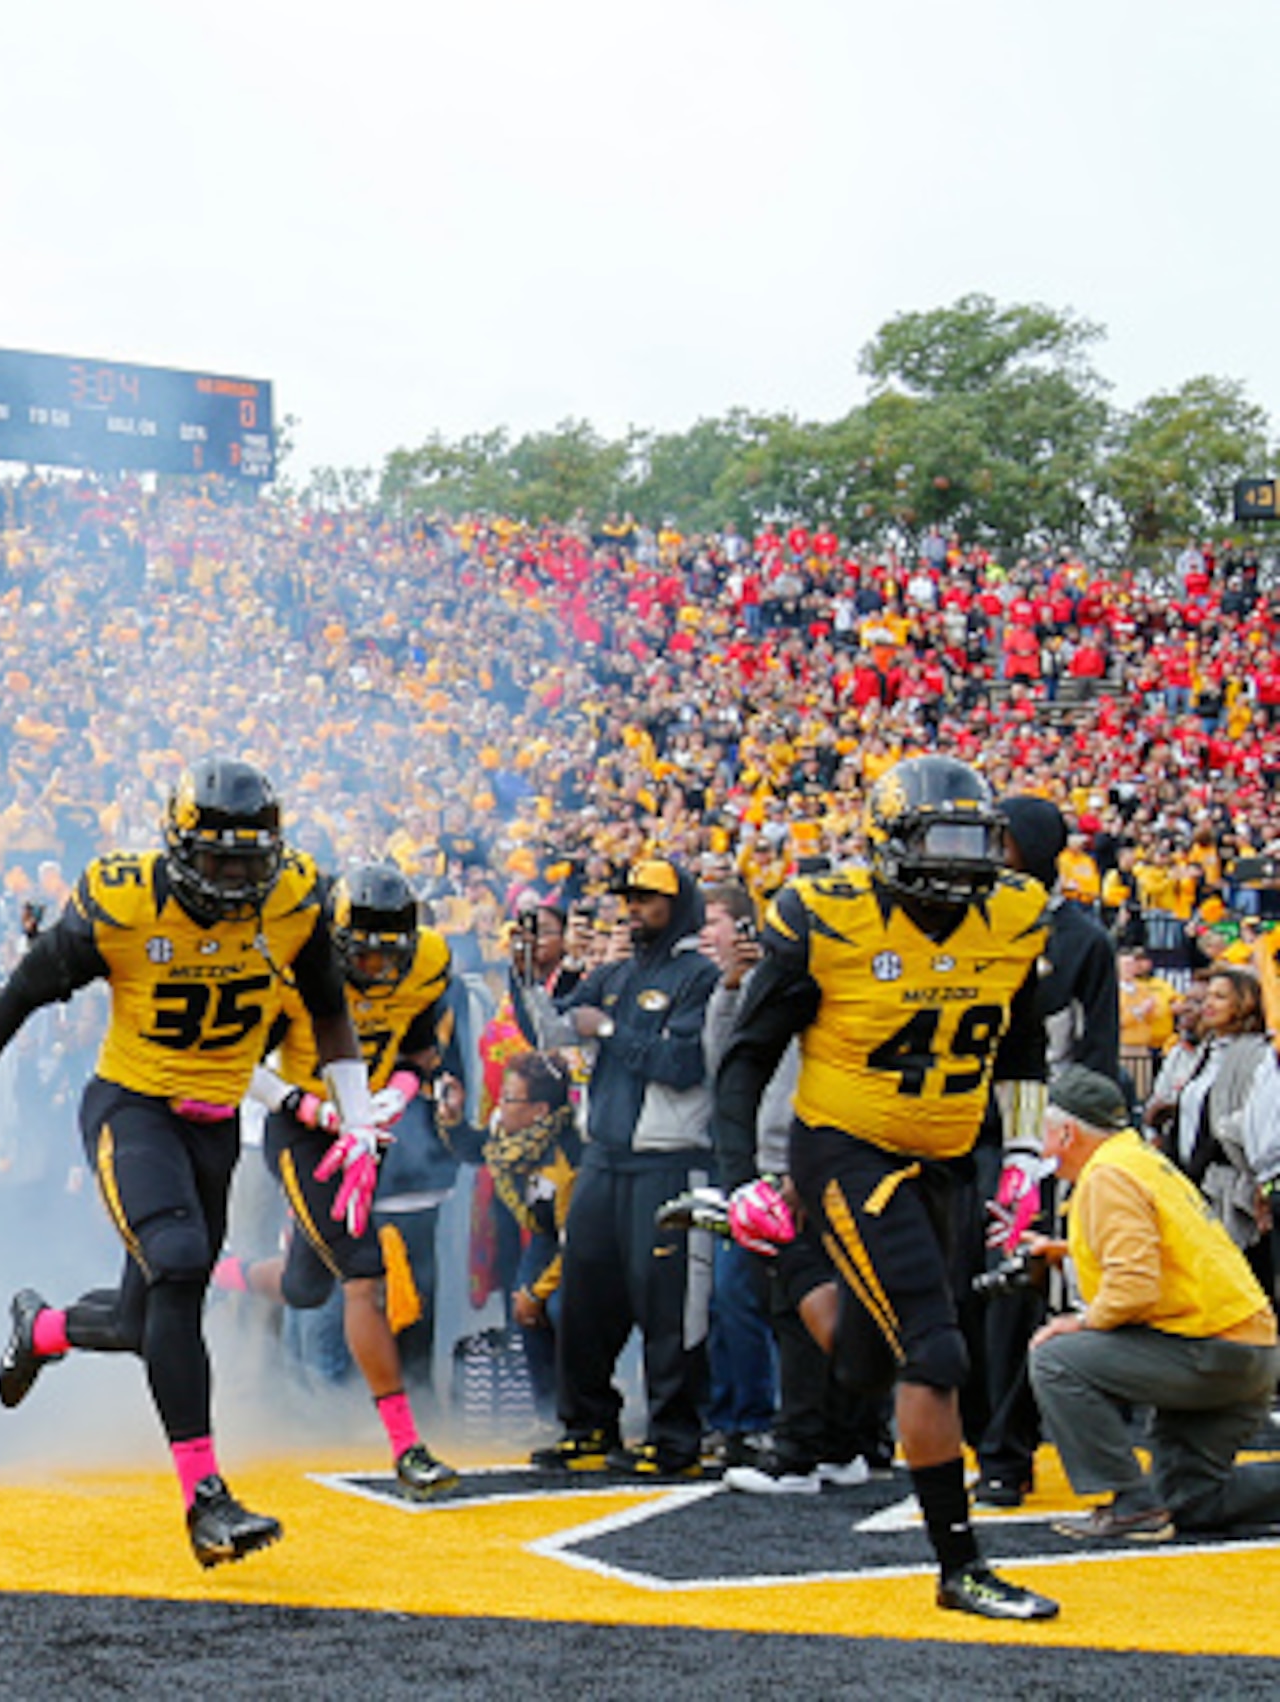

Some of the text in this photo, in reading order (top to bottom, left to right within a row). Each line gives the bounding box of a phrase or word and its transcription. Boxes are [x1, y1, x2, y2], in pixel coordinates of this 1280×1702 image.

[239, 398, 257, 429] 0
[139, 974, 271, 1051] 35
[866, 1003, 1004, 1095] 49
